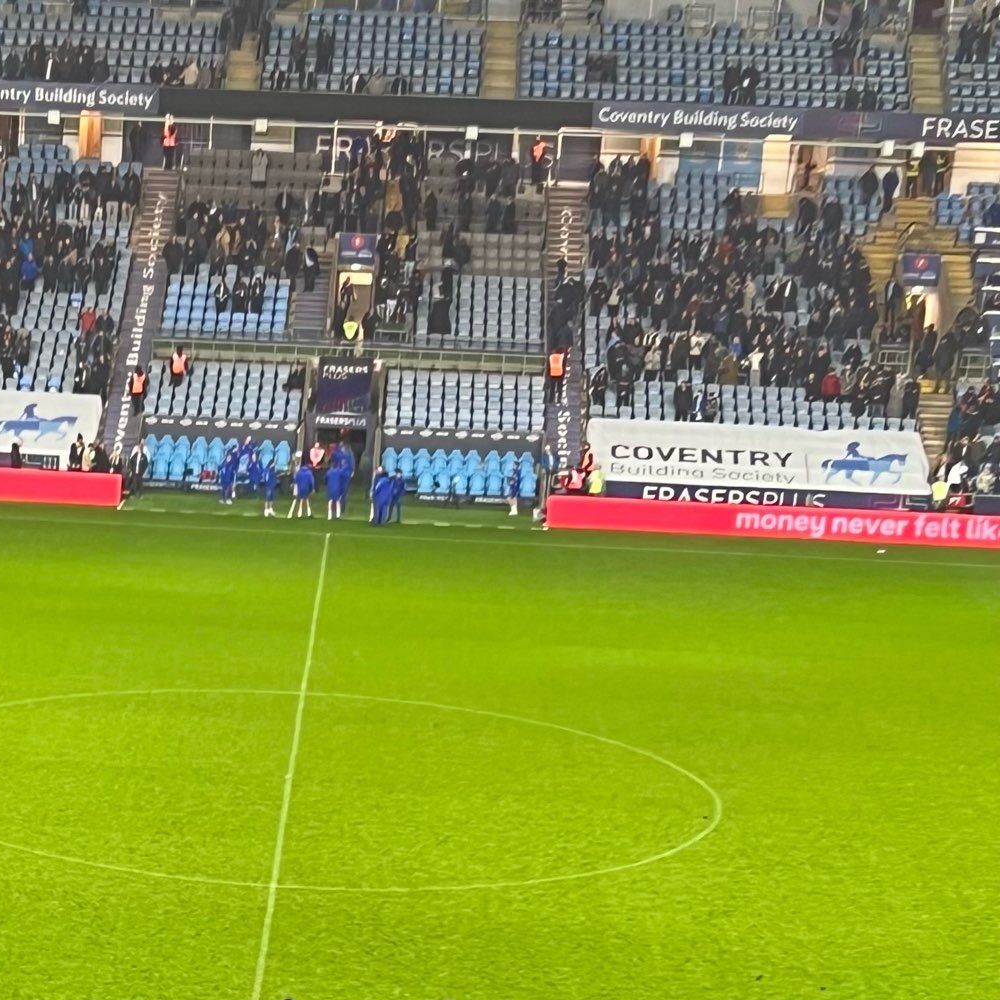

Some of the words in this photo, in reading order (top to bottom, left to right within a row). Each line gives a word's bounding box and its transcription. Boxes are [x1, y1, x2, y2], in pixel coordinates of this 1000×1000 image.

[35, 87, 96, 108] Building
[99, 90, 154, 110] Society
[598, 106, 671, 128] Coventry
[673, 109, 738, 131] Building
[739, 112, 799, 132] Society
[921, 117, 1000, 139] FRASE
[611, 444, 793, 468] COVENTRY
[610, 462, 704, 479] Building
[712, 467, 796, 484] Society
[735, 511, 826, 537] money
[831, 517, 909, 536] never
[914, 515, 961, 539] felt
[966, 516, 1000, 541] lik
